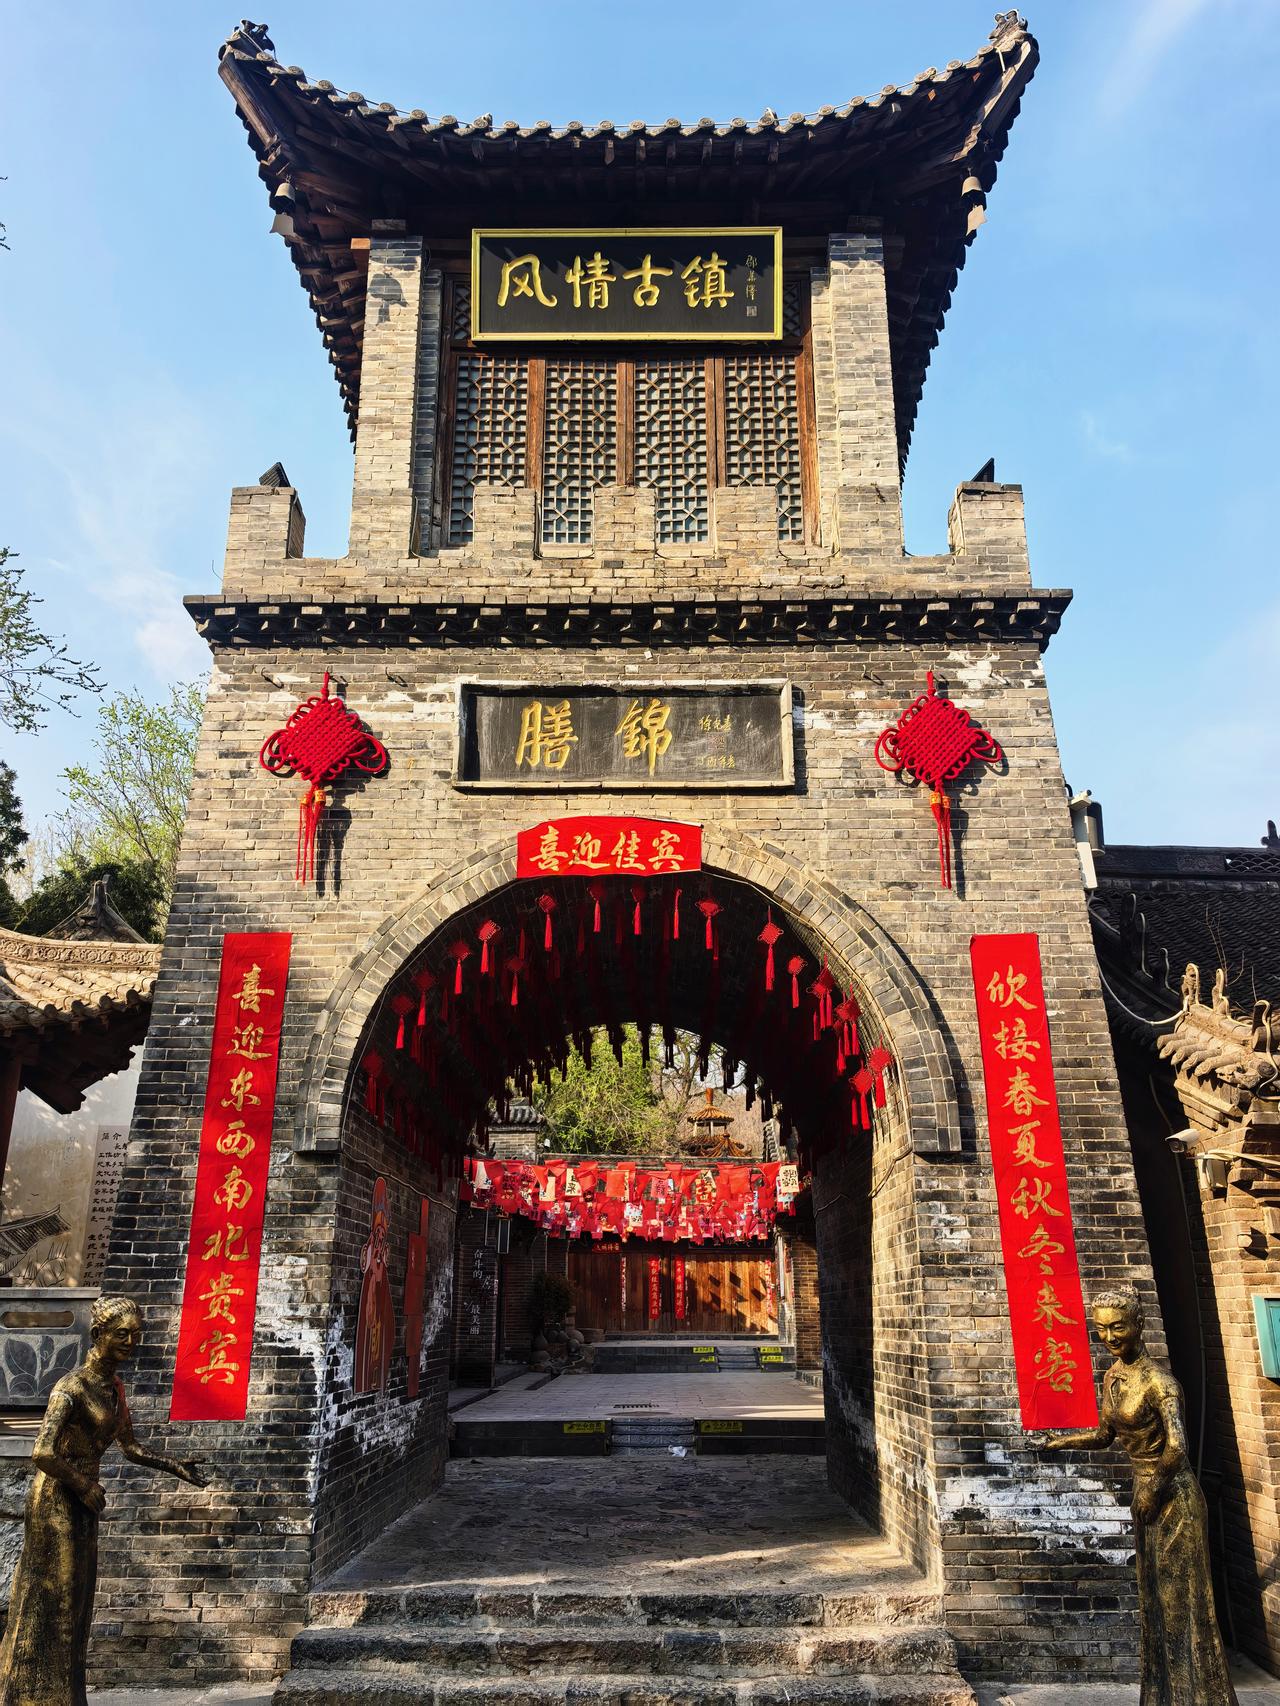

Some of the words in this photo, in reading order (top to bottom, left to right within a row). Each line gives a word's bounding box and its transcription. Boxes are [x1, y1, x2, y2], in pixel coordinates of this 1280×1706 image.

[497, 251, 735, 309] 风情古镇
[529, 825, 685, 871] 喜迎佳宾
[194, 963, 275, 1385] 喜迎东西南北贵宾
[986, 964, 1079, 1394] 欣接春夏秋冬来客
